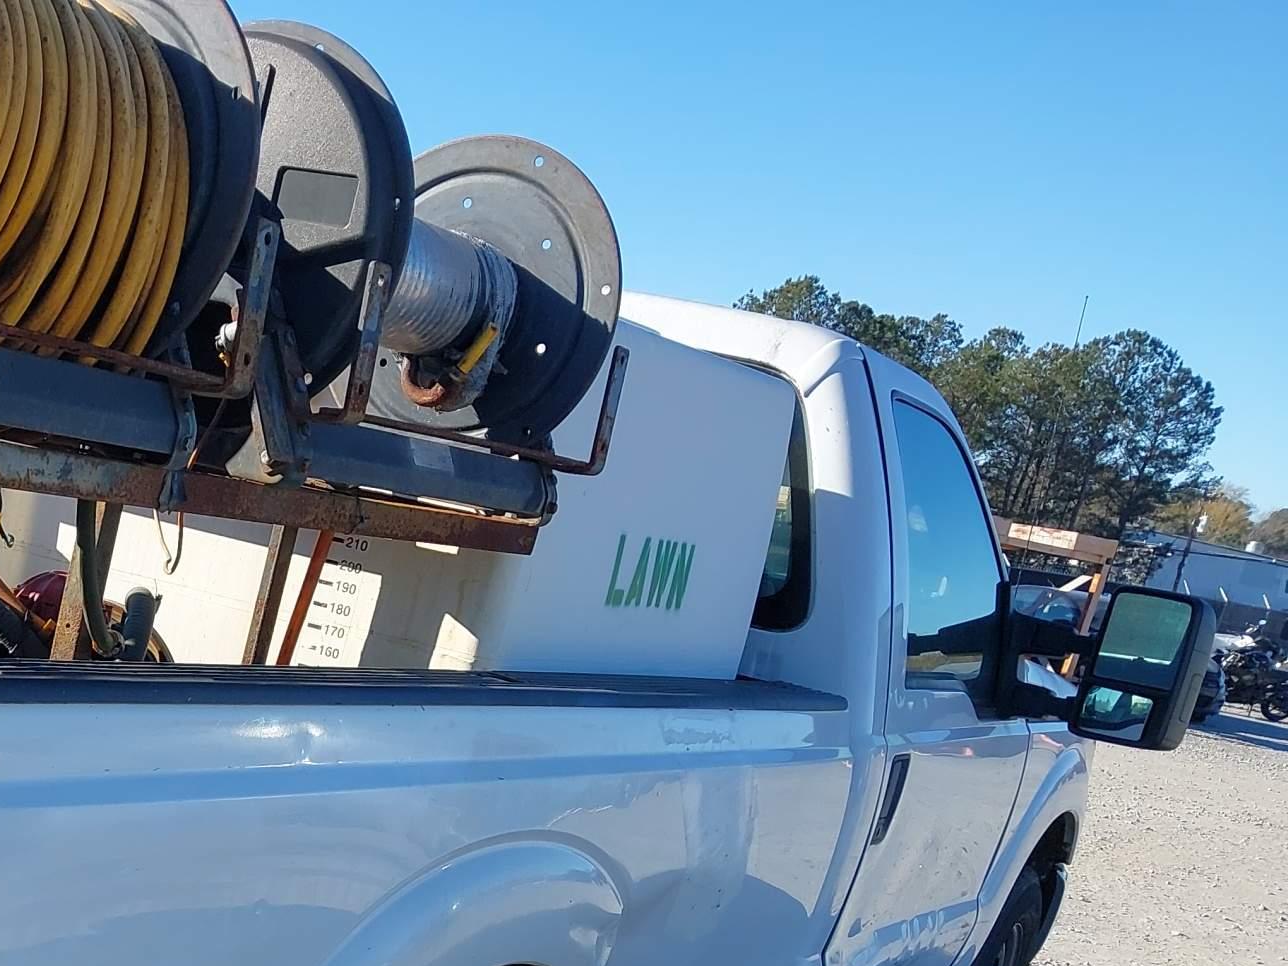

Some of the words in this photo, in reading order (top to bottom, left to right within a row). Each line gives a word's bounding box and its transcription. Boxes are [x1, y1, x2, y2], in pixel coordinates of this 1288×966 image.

[345, 536, 369, 551] 210
[339, 559, 363, 574] 200
[604, 533, 696, 610] LAWN
[336, 581, 357, 595] 190
[330, 602, 351, 617] 180
[324, 625, 345, 639] 170
[319, 645, 340, 660] 160
